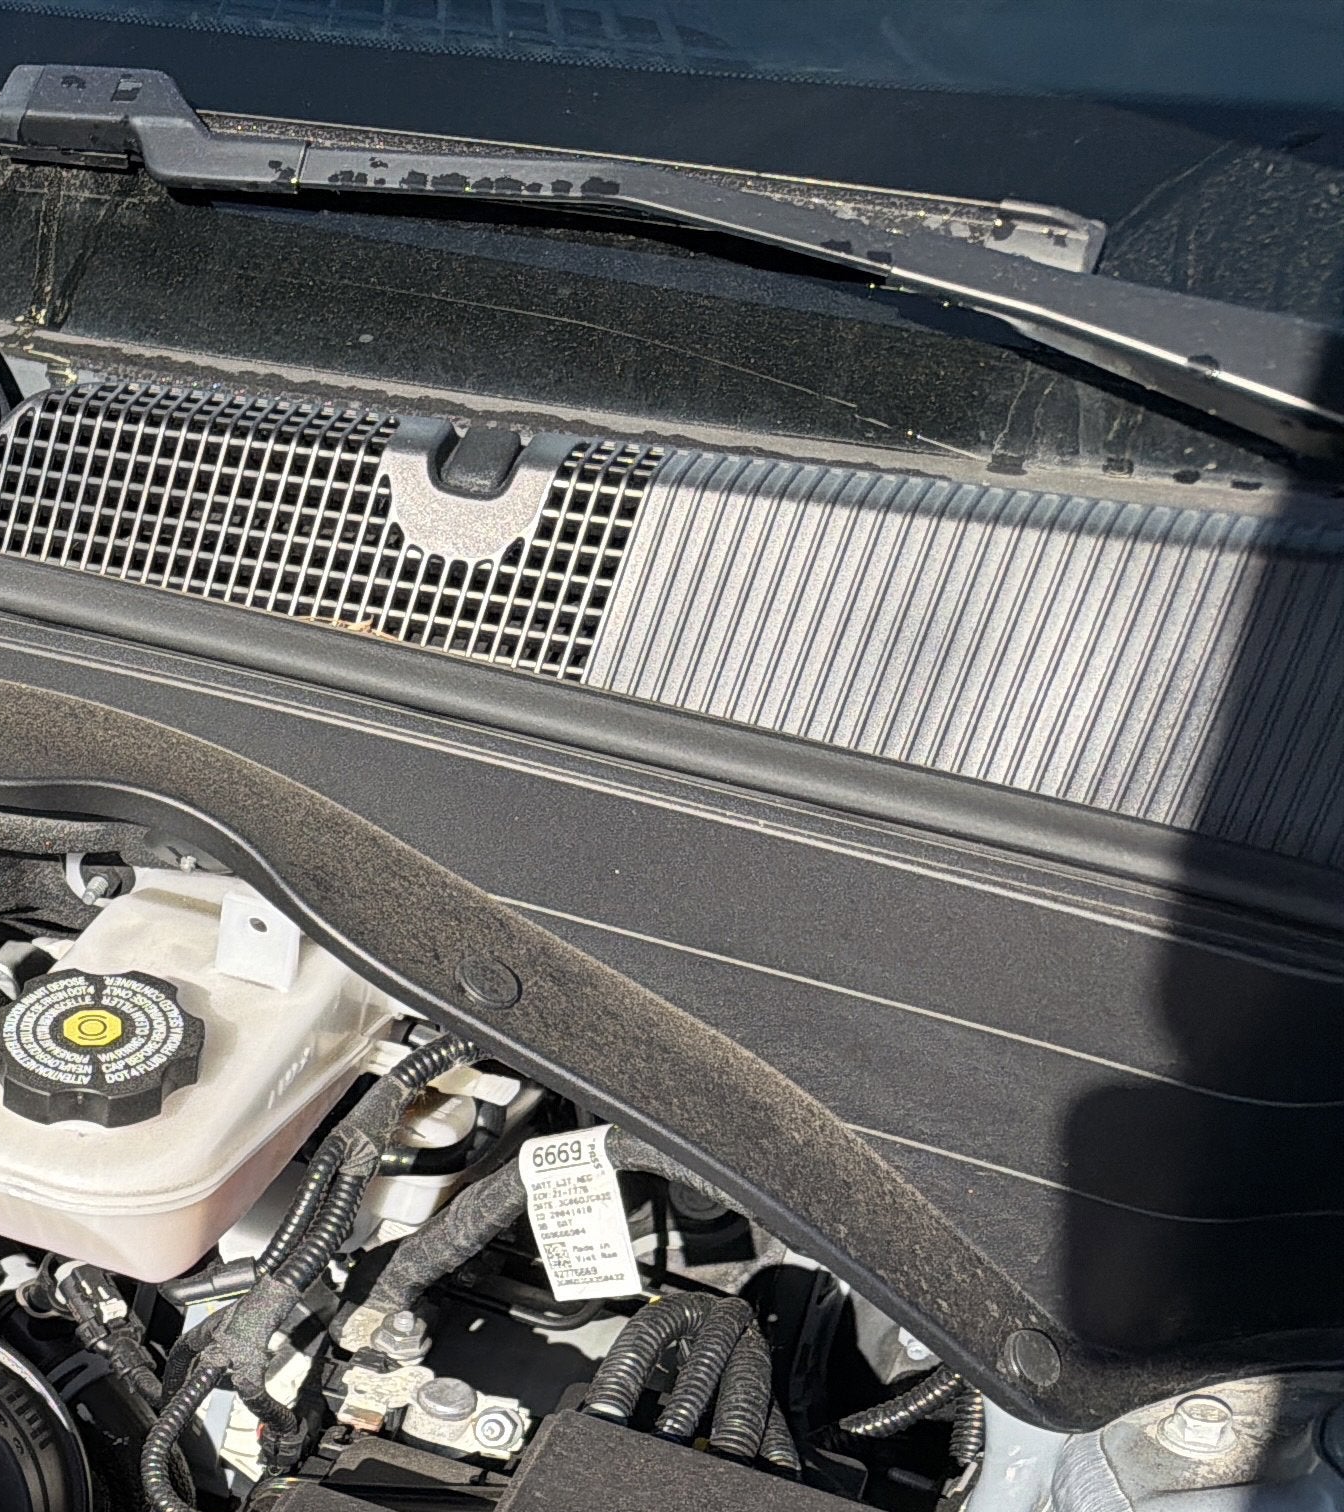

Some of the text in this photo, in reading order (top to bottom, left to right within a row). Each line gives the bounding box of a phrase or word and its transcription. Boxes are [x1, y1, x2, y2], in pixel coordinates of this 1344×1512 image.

[102, 985, 134, 999] ONLY
[123, 1040, 162, 1066] BEFORE
[139, 1052, 169, 1073] FLUID
[101, 1059, 128, 1073] CAP
[532, 1140, 582, 1167] 6669
